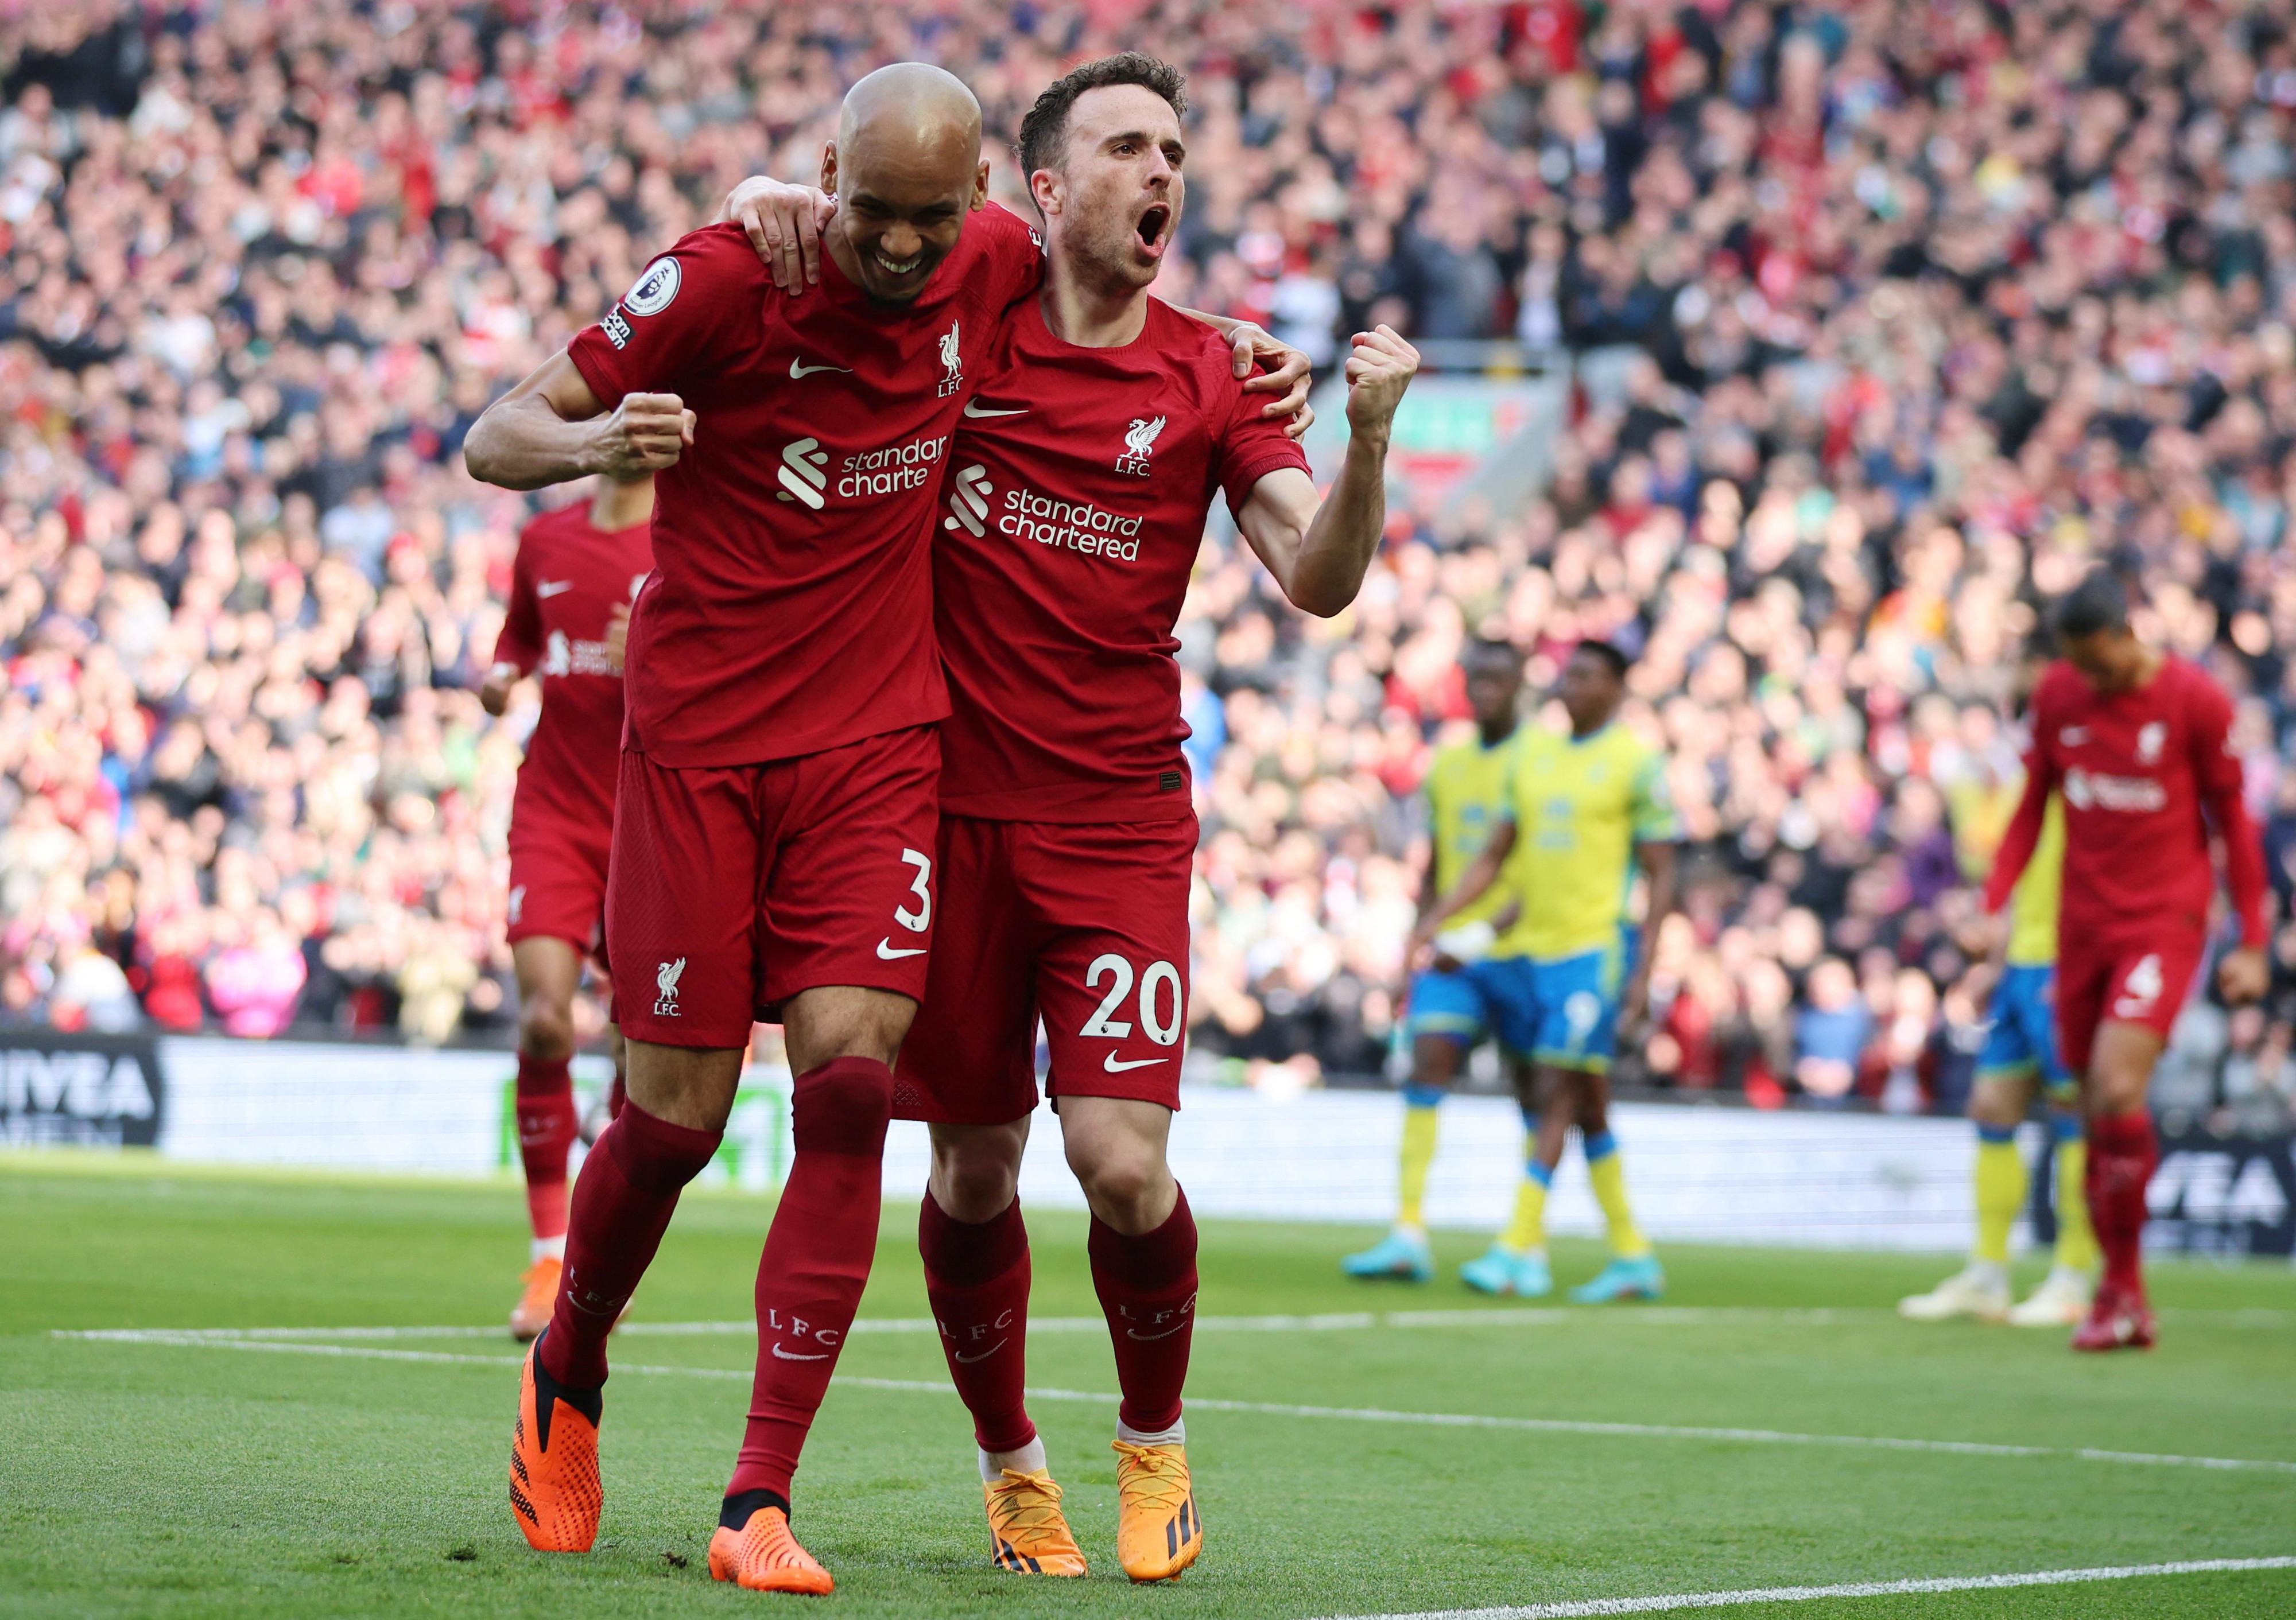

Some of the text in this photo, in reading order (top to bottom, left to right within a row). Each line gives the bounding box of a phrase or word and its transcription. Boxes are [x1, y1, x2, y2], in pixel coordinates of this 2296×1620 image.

[644, 296, 662, 309] League
[841, 436, 947, 473] standar
[1114, 458, 1150, 476] L.F.C.
[1004, 488, 1143, 537] standard
[999, 513, 1140, 562] chartered
[894, 848, 932, 933] 3
[654, 1002, 681, 1016] L.F.C.
[1079, 953, 1183, 1046] 20
[0, 1050, 155, 1121] IVEA
[769, 1308, 839, 1345] LFC
[938, 1308, 1011, 1341] LFC
